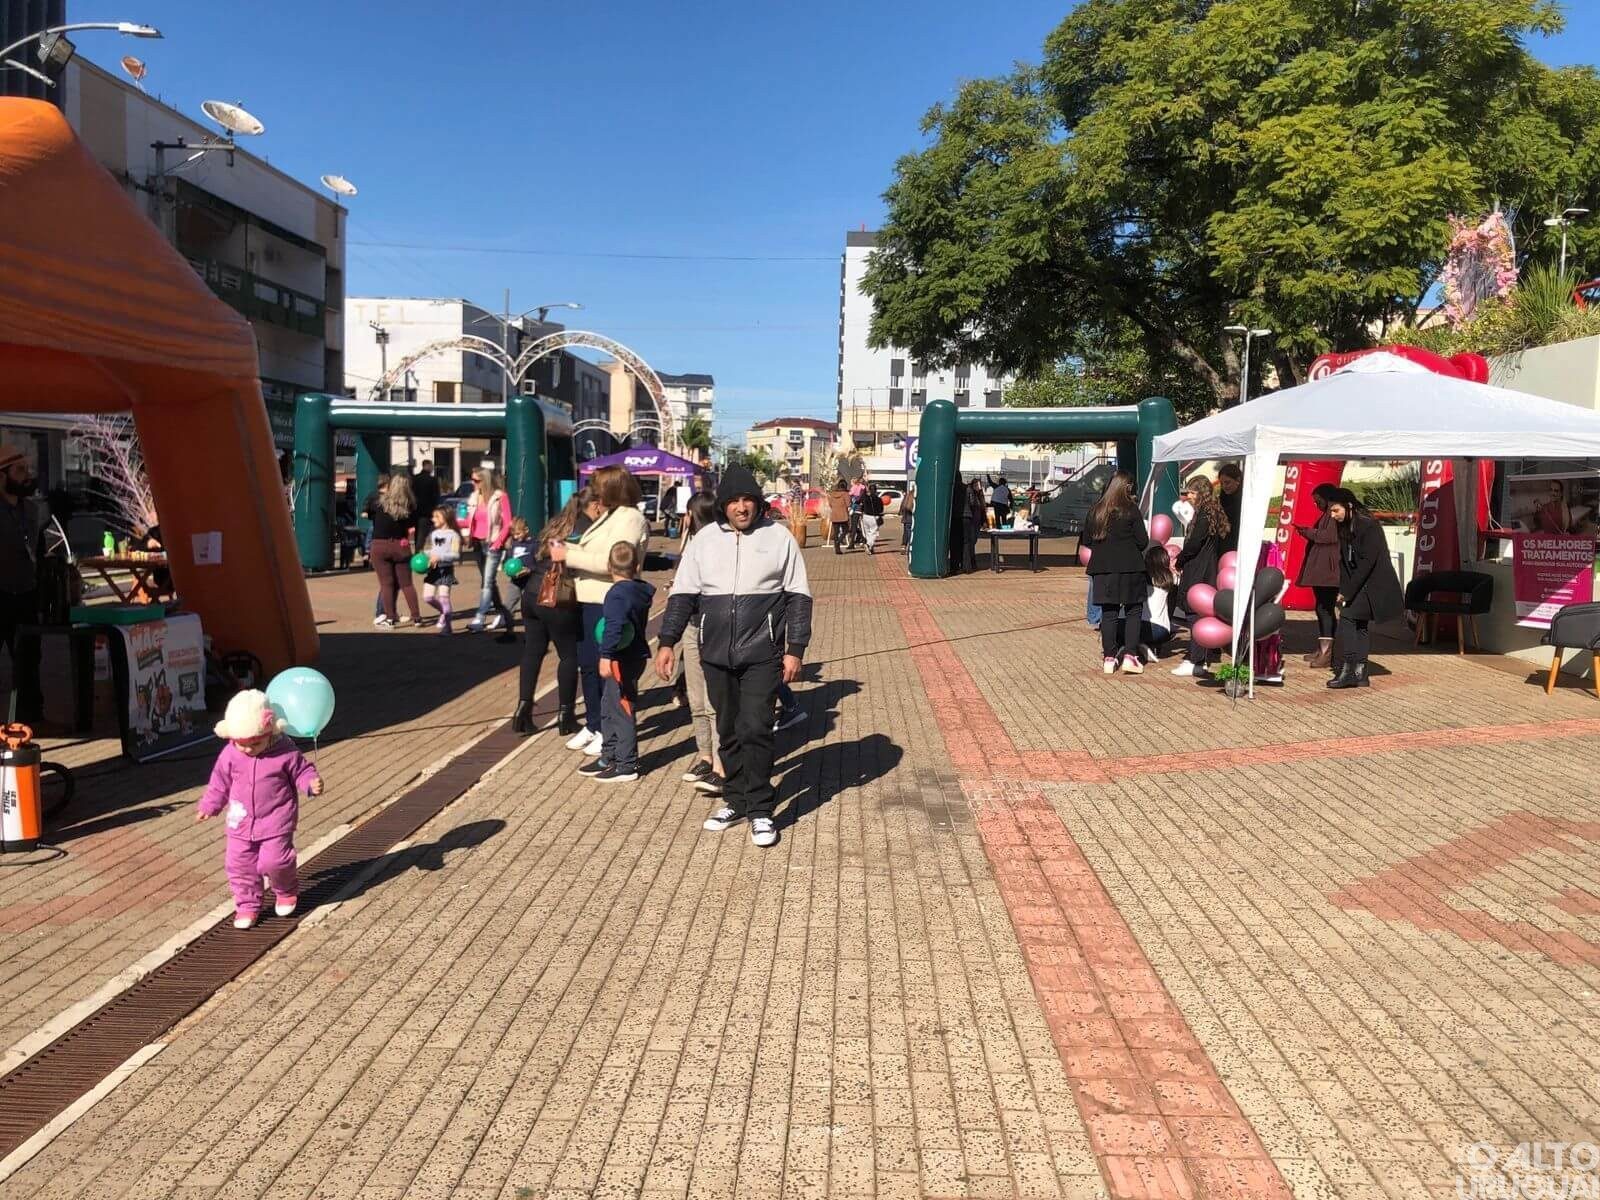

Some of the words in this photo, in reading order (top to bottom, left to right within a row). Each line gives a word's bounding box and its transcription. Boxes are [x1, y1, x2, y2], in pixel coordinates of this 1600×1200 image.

[1523, 540, 1536, 549] OS
[1537, 540, 1593, 550] MELHORES
[1521, 550, 1595, 561] TRATAMENTOS
[3, 790, 11, 815] STIHL
